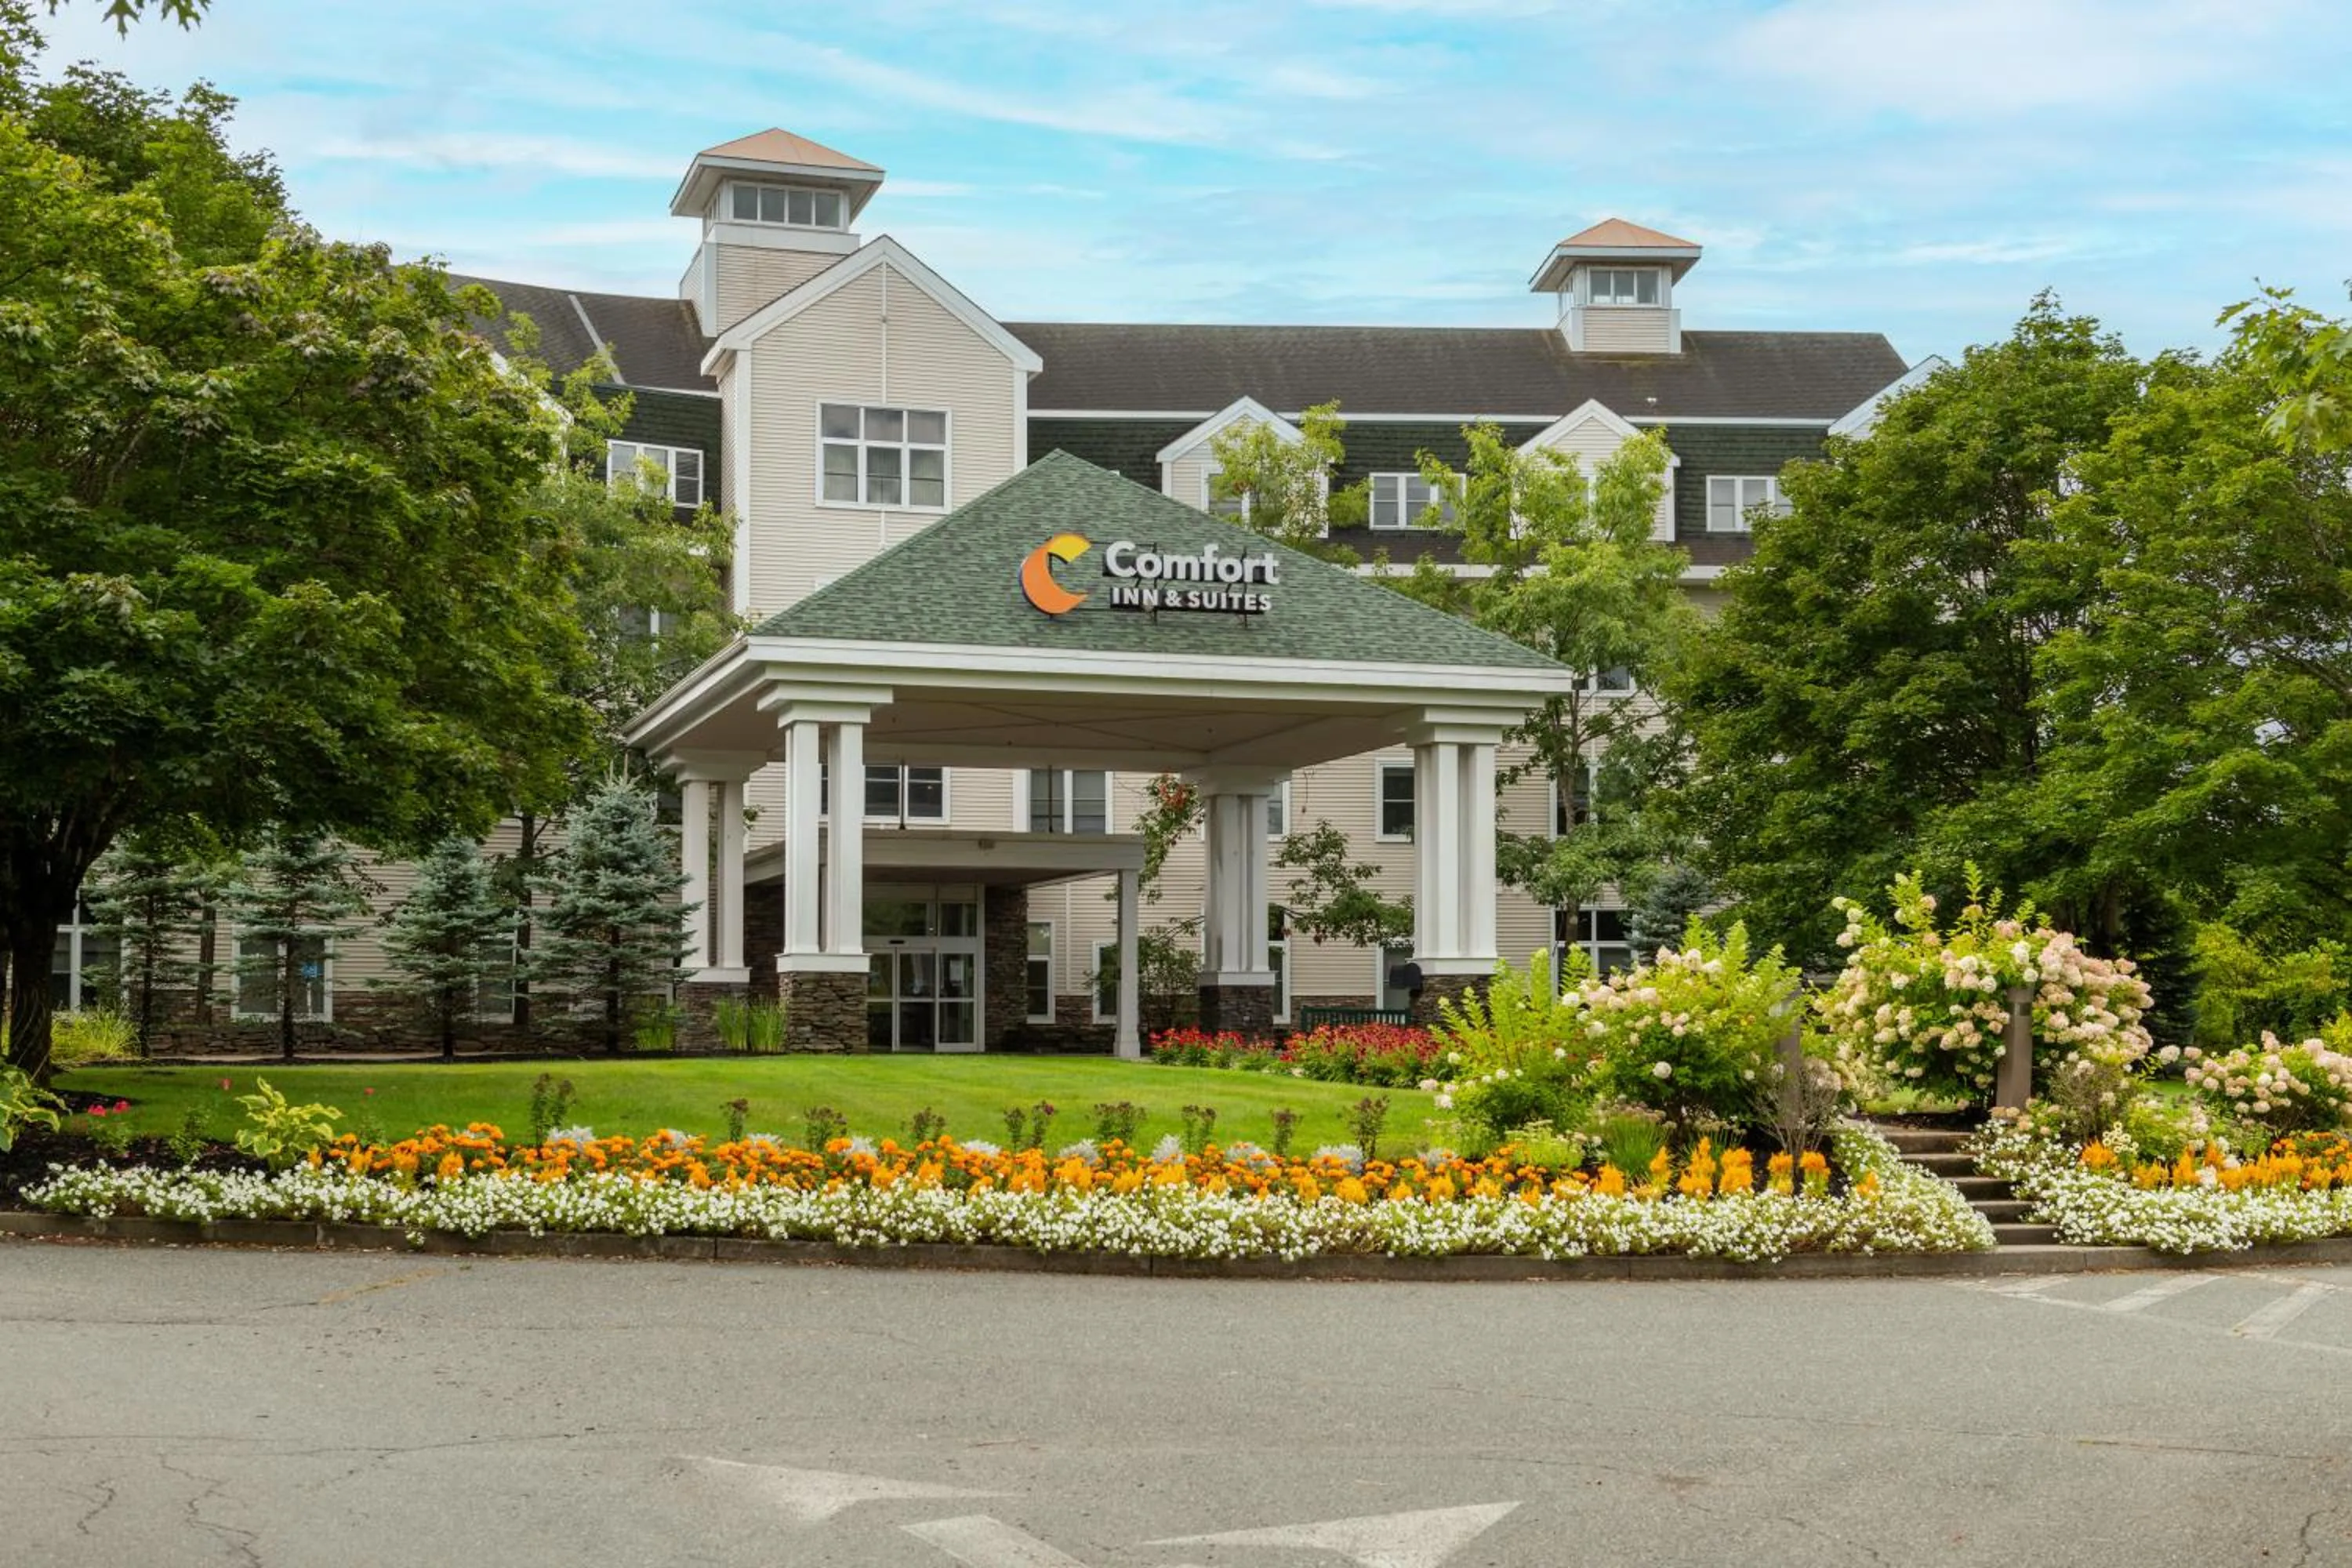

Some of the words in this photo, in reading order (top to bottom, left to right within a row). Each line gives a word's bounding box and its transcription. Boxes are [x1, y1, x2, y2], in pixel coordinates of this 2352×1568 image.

[1105, 540, 1279, 584] Comfort
[1112, 588, 1158, 606] INN
[1164, 590, 1184, 608] &
[1188, 590, 1272, 612] SUITES
